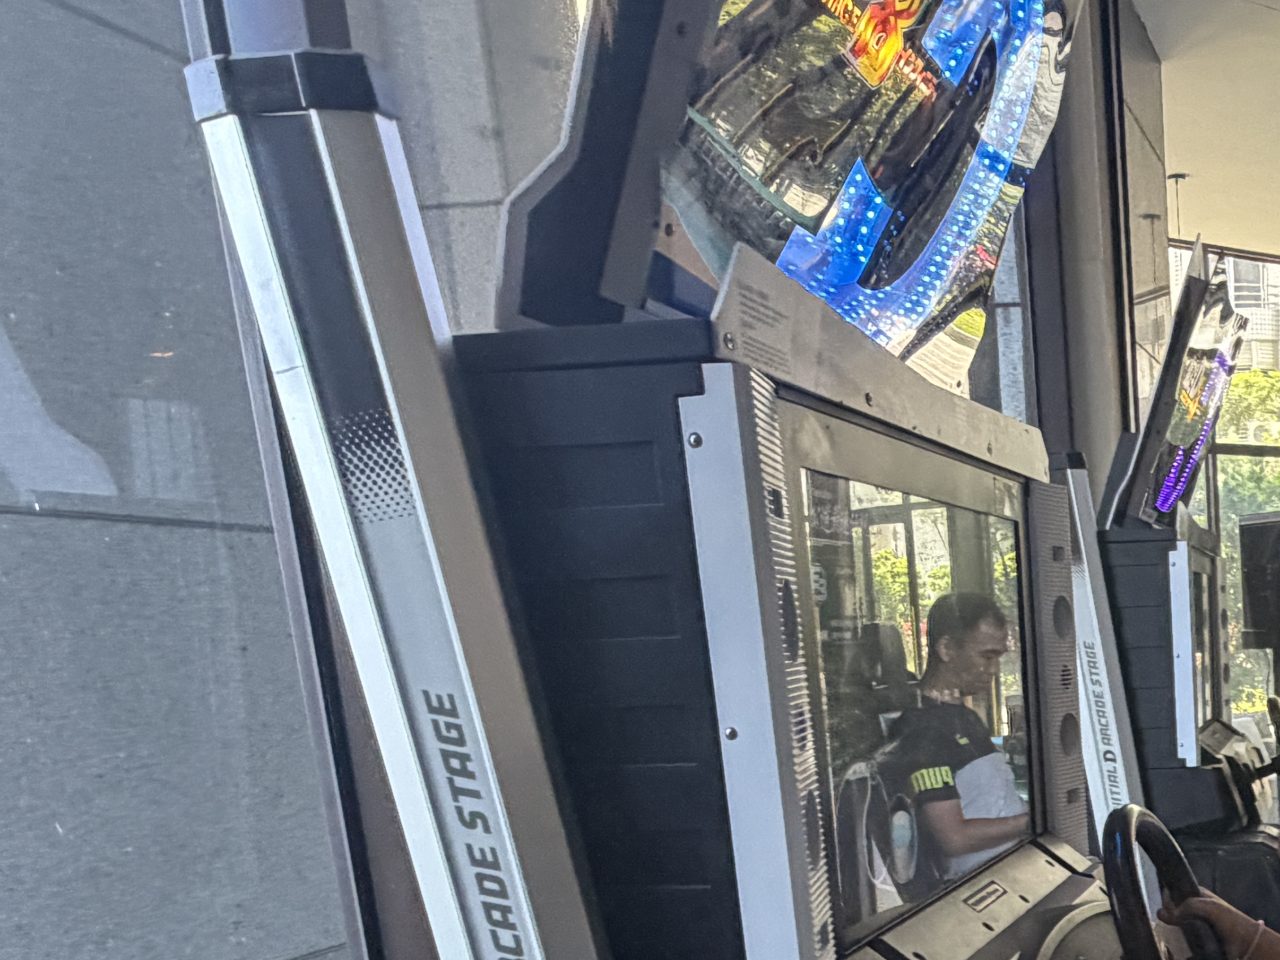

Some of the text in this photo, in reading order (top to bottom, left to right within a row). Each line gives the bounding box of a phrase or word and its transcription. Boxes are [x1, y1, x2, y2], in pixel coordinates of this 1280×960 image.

[422, 689, 493, 835] STAGE
[1083, 640, 1123, 809] ITIAL D ARCADE STAGE
